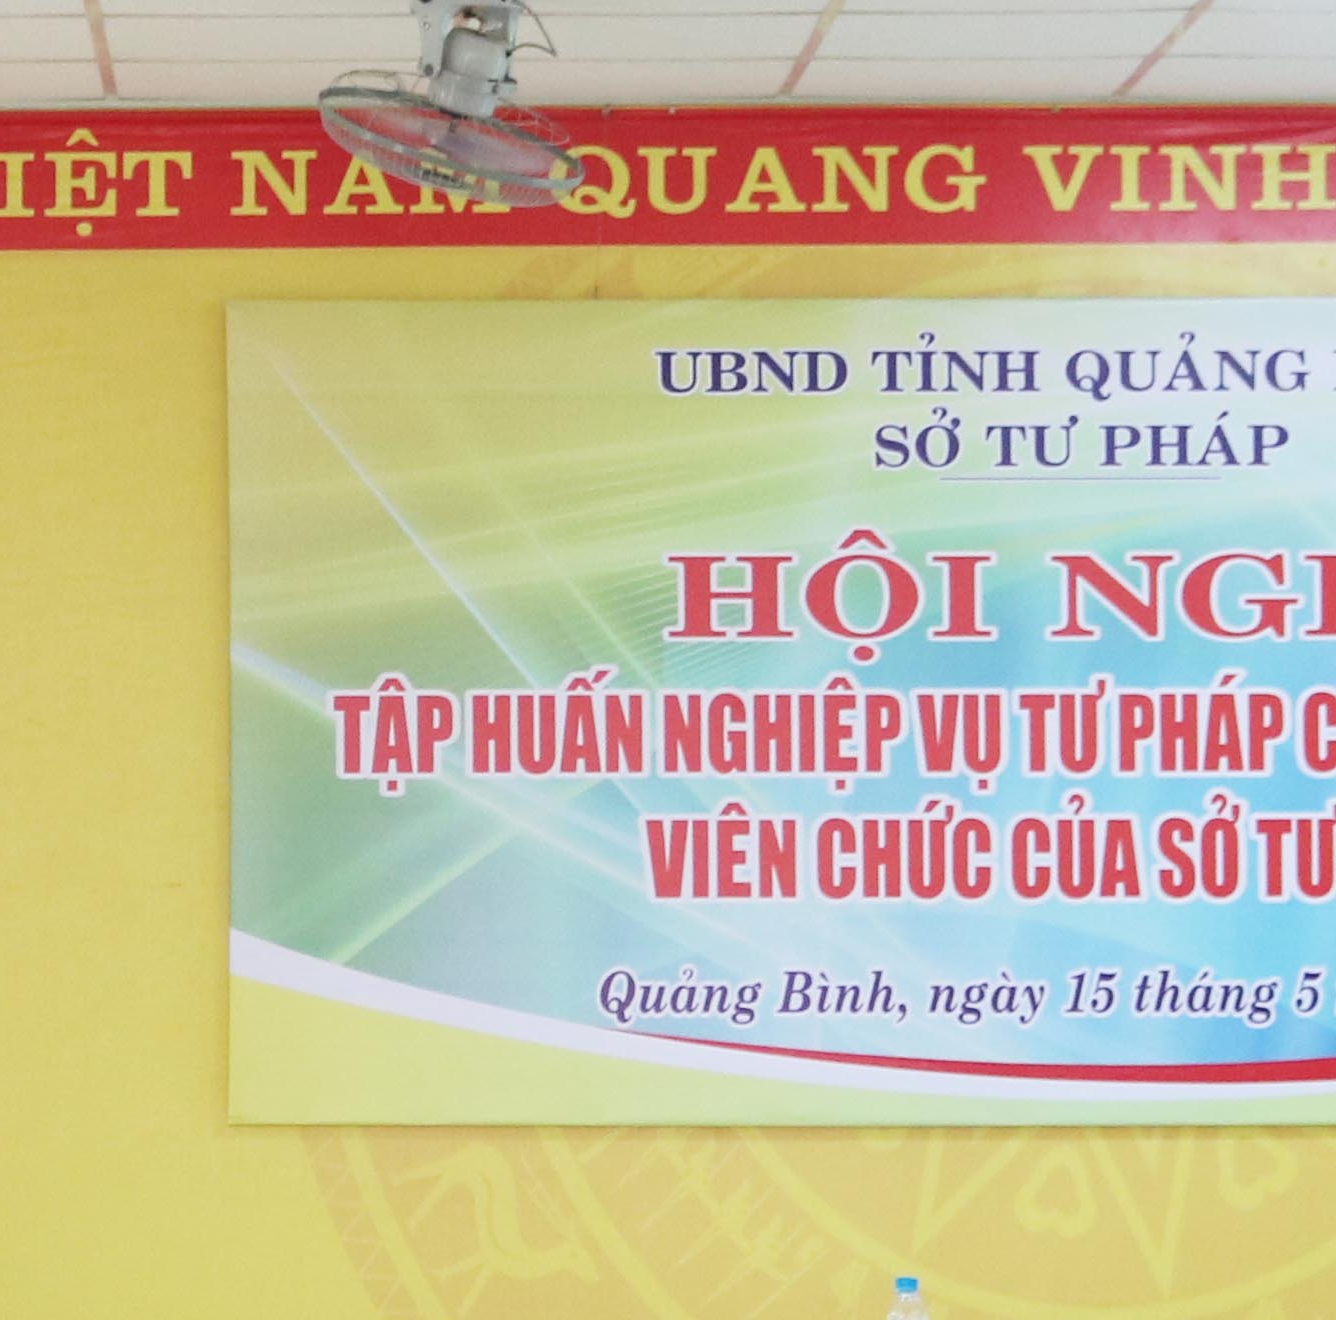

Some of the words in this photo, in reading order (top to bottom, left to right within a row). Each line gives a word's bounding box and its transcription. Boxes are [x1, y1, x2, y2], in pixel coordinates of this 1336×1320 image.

[549, 144, 987, 218] QUANG
[1023, 143, 1336, 212] VINH
[656, 351, 848, 394] UBND
[872, 332, 1039, 392] TỈNH
[1065, 333, 1309, 402] QUẢNG
[875, 407, 961, 468] SỞ
[986, 415, 1079, 467] TƯ
[1101, 411, 1289, 466] PHÁP
[668, 528, 993, 661] HỘI
[335, 678, 453, 790] TẬP
[473, 671, 642, 774] HUẤN
[665, 677, 901, 789] NGHIỆP
[919, 694, 1001, 789] VỤ
[1020, 681, 1106, 772] TƯ
[1120, 675, 1283, 771] PHÁP
[648, 803, 796, 897] VIÊN
[818, 800, 991, 898] CHỨC
[1013, 795, 1140, 898] CỦA
[1159, 795, 1240, 898] SỞ
[600, 970, 762, 1024] Quảng
[779, 970, 907, 1019] Bình,
[930, 972, 1045, 1025] ngày
[1067, 972, 1117, 1013] 15
[1135, 970, 1278, 1023] tháng
[1296, 972, 1321, 1012] 5
